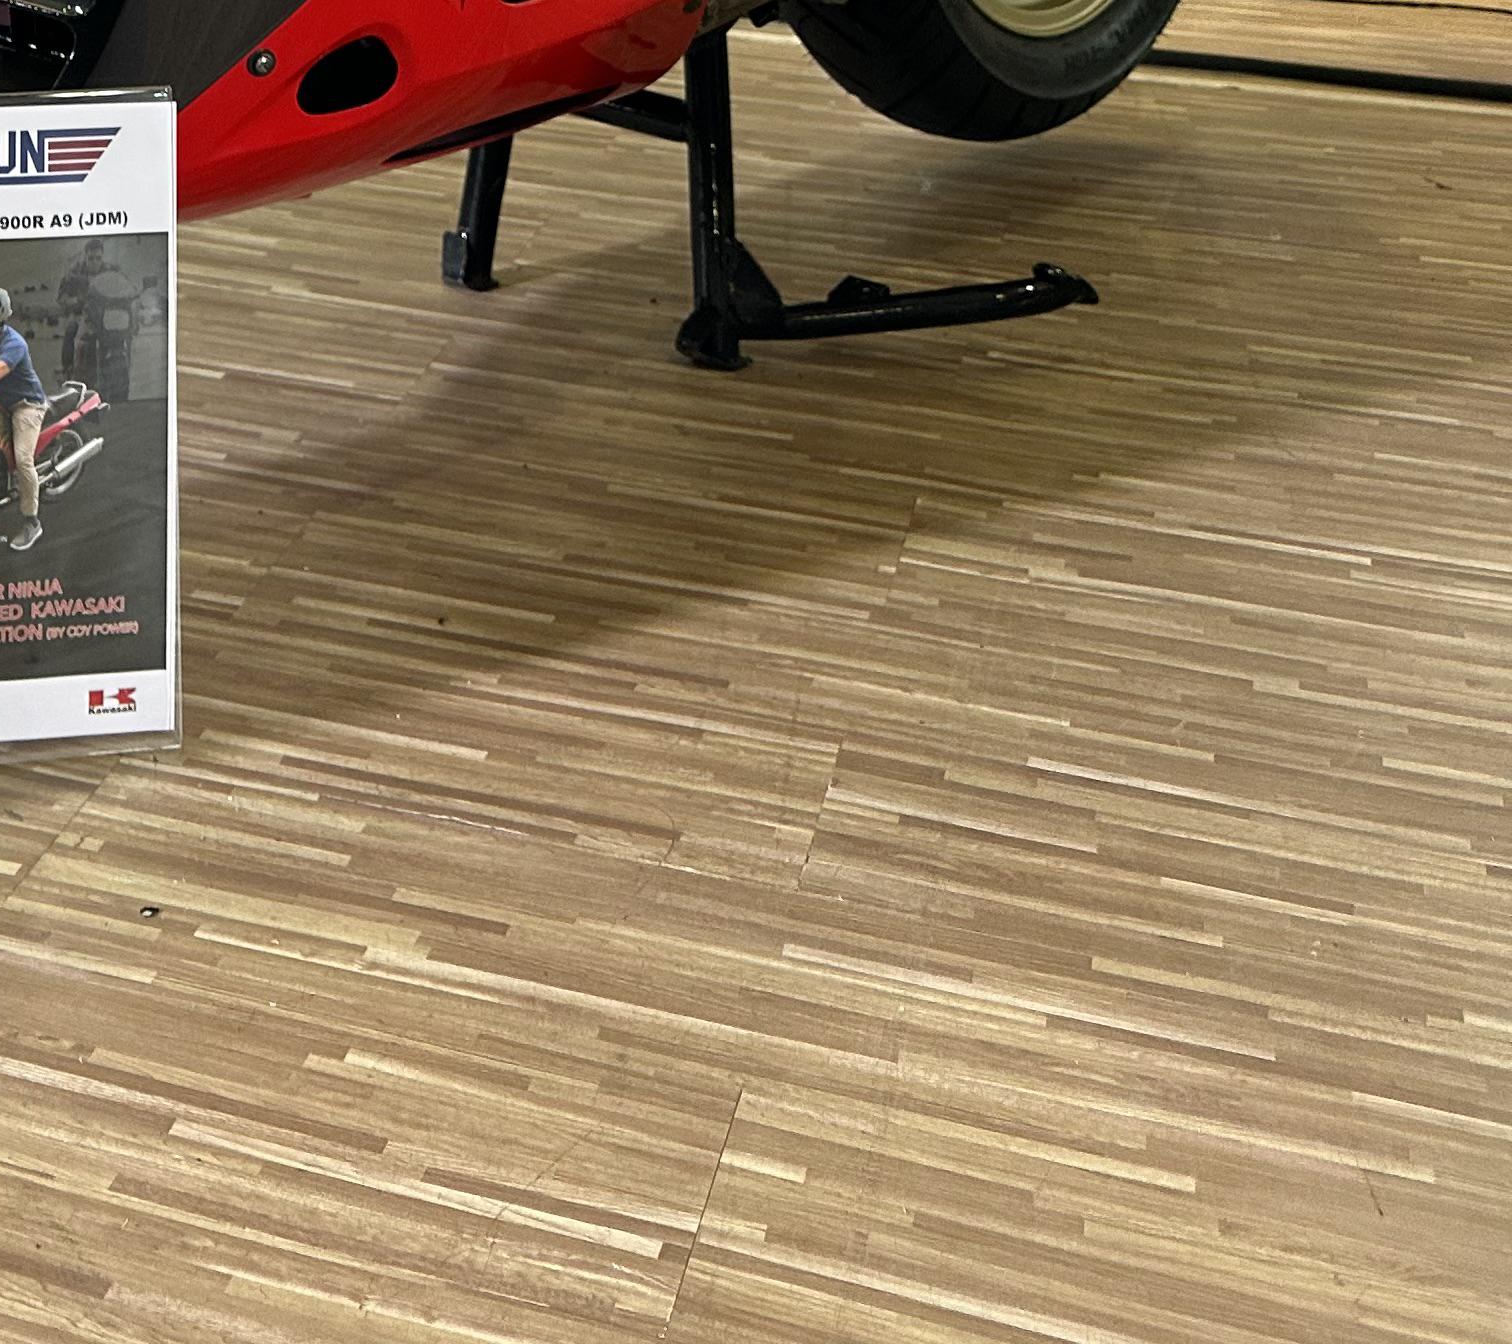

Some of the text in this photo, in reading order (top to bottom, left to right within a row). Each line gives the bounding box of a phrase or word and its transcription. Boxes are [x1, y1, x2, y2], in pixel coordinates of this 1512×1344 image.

[0, 214, 45, 230] 900R
[50, 213, 73, 228] A9
[78, 210, 129, 230] (JDM)
[8, 577, 64, 600] NINJA
[31, 595, 126, 619] KAWASAKI
